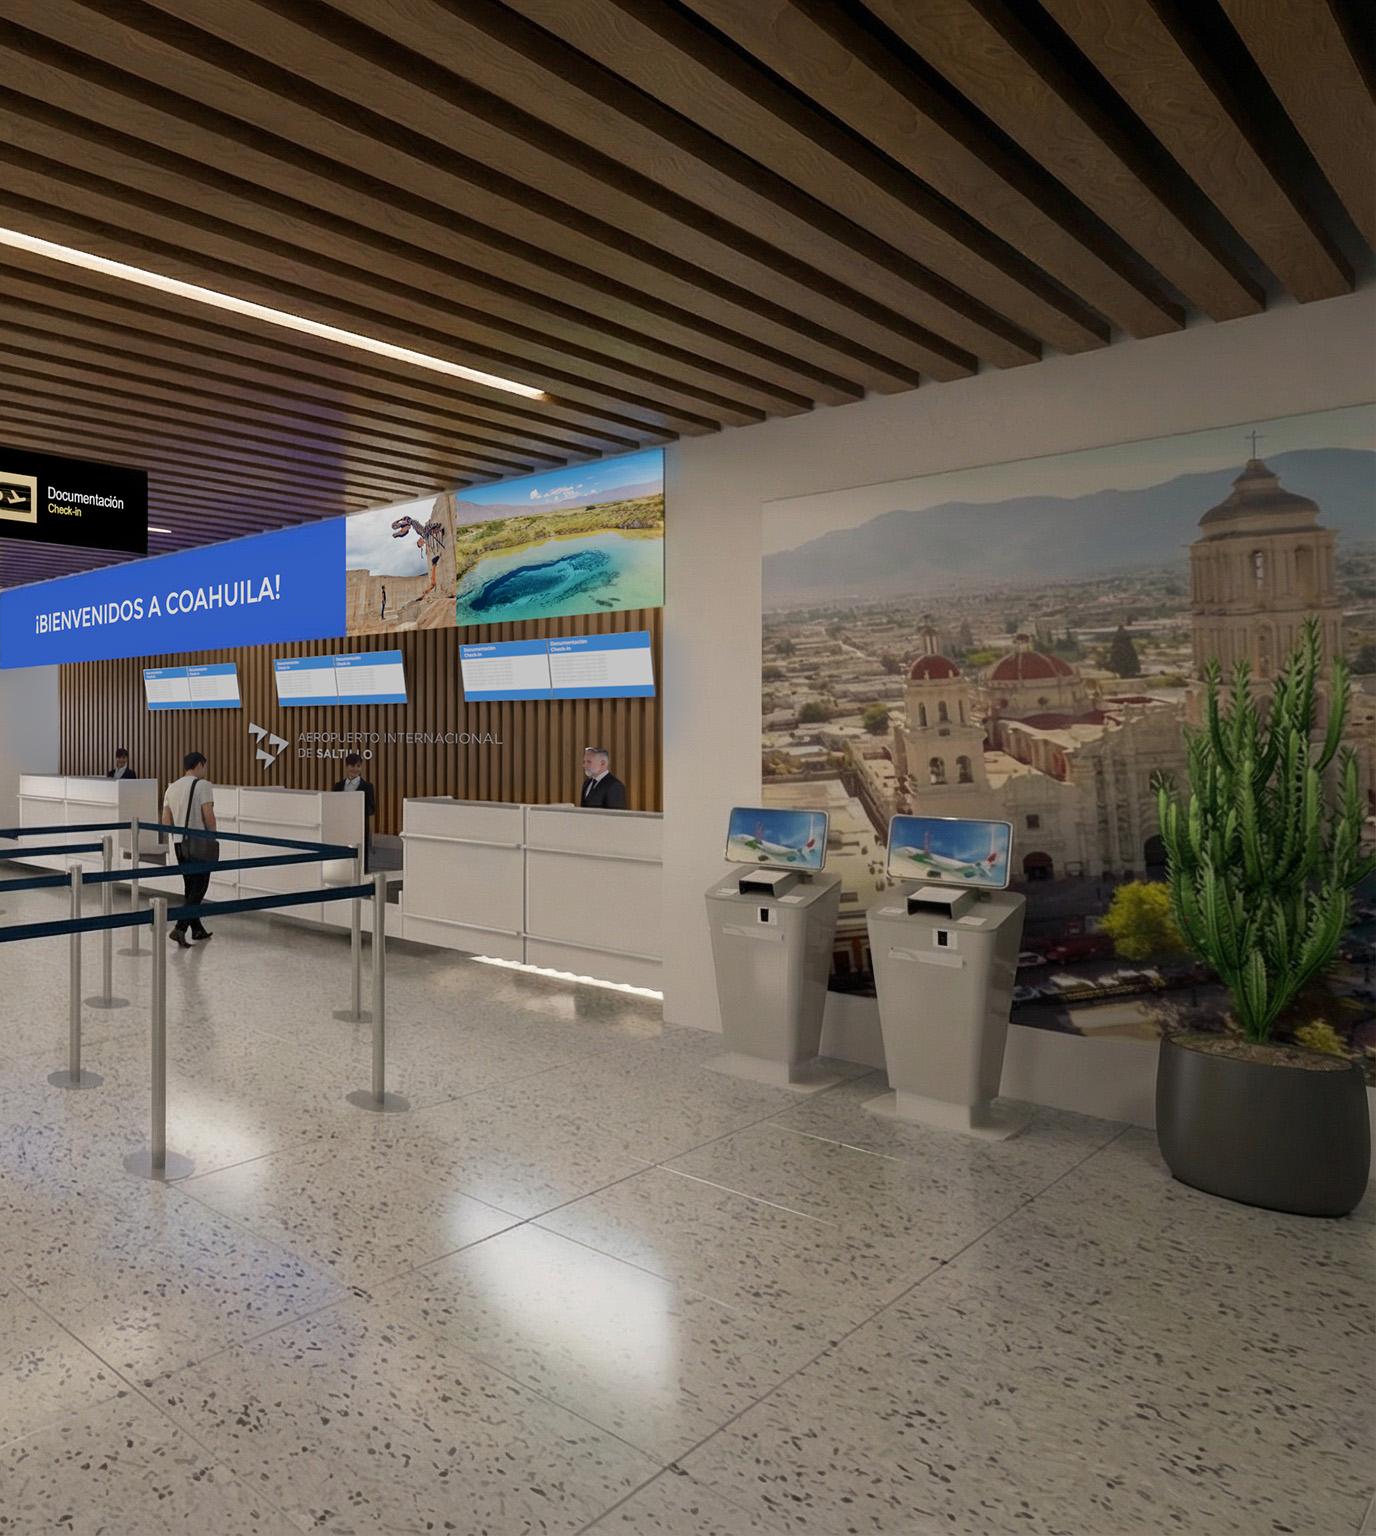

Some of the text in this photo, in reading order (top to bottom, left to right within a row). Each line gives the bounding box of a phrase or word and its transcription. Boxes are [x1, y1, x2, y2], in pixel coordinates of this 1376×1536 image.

[47, 485, 124, 510] Documentación
[48, 502, 82, 517] Check-in
[35, 574, 281, 634] ¡BIENVENIDOS A COAHUILA!
[297, 732, 503, 745] AEROPUERTO INTERNACIONAL
[298, 748, 312, 758] DE
